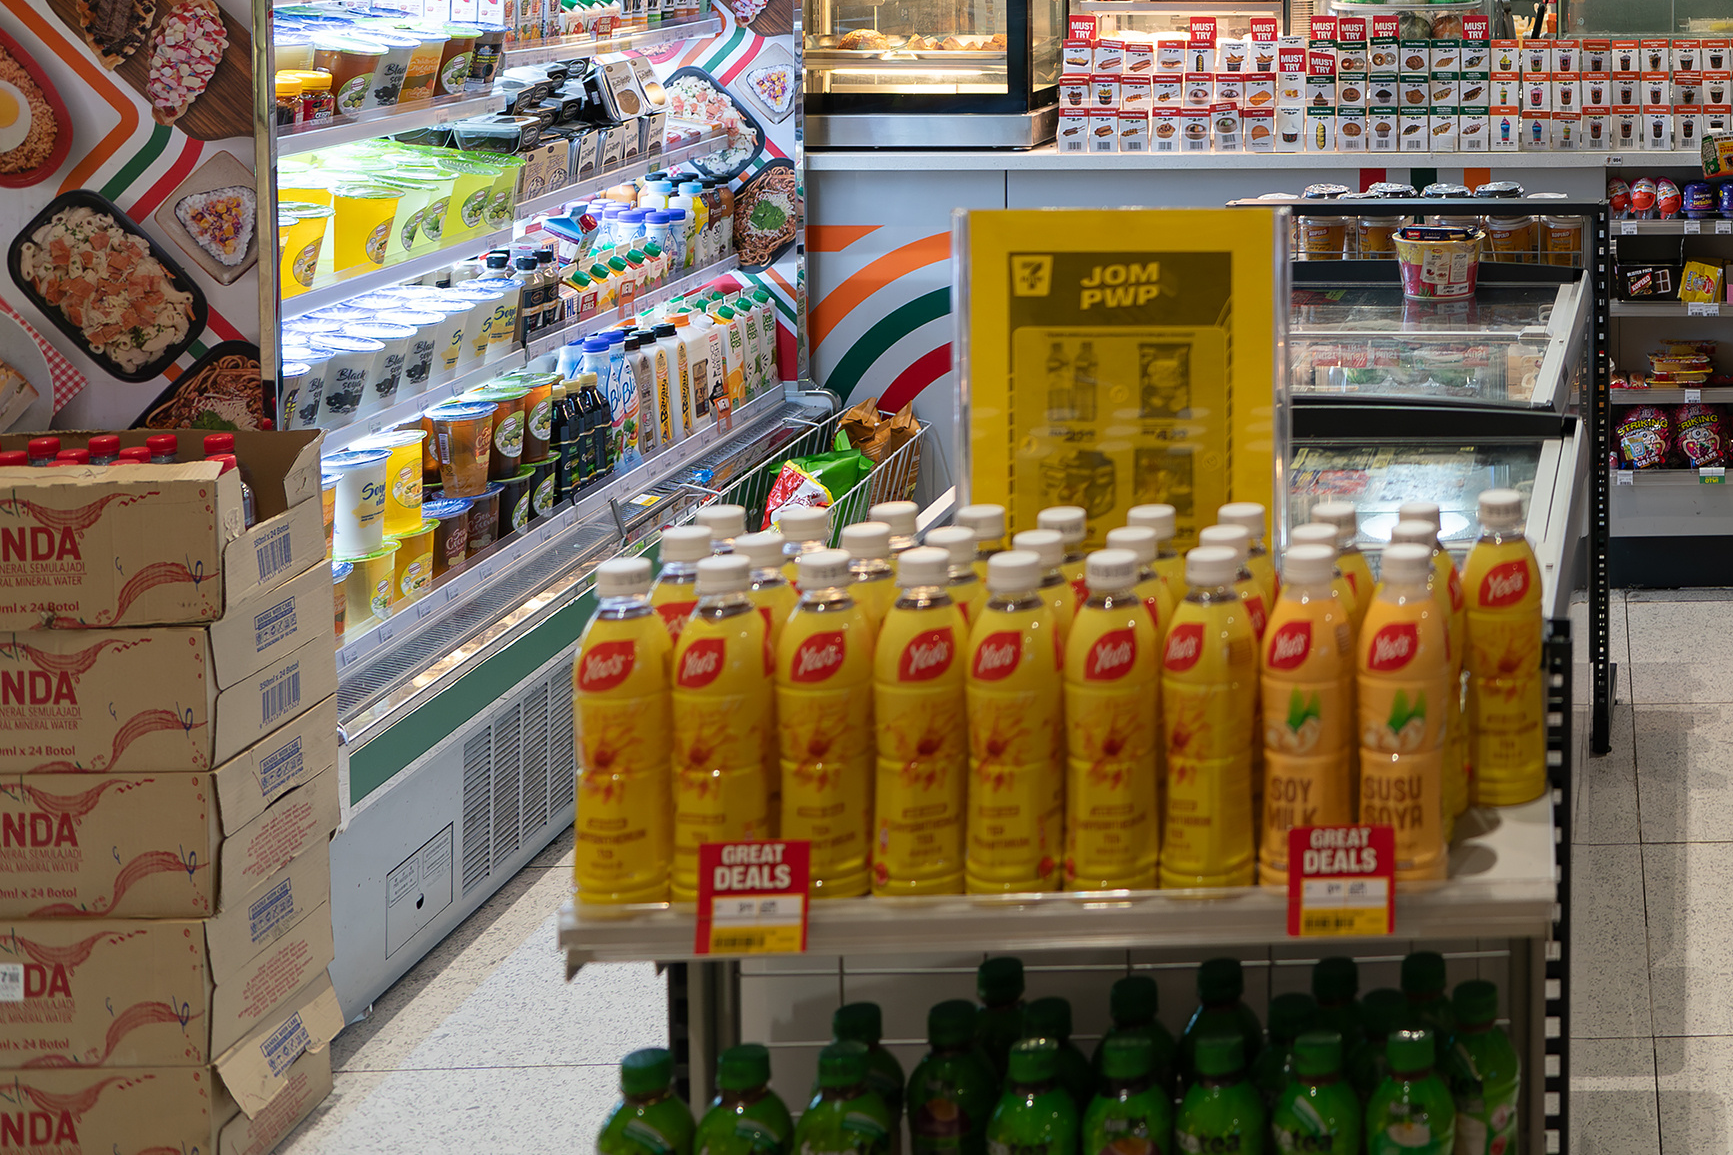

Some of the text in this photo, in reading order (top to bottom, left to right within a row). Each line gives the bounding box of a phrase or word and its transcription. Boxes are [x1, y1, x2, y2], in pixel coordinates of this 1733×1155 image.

[1071, 21, 1094, 30] MUST
[1074, 30, 1090, 39] TRY
[1312, 22, 1336, 31] MUST
[1316, 31, 1332, 40] TRY
[1464, 22, 1487, 31] MUST
[1467, 30, 1483, 39] TRY
[1079, 261, 1161, 288] JOM
[1079, 284, 1161, 311] PWP
[337, 368, 367, 382] Black
[1617, 417, 1669, 437] STRIKING
[1637, 455, 1661, 470] GRAPE
[54, 576, 82, 586] WATER
[28, 601, 80, 613] 24 Botol
[1271, 775, 1313, 803] SOY
[1364, 775, 1423, 802] SUSU
[1268, 804, 1317, 829] MILK
[1364, 804, 1424, 830] SOYA
[1309, 827, 1371, 848] GREAT
[721, 843, 787, 866] GREAT
[1302, 848, 1378, 875] DEALS
[713, 864, 791, 891] DEALS
